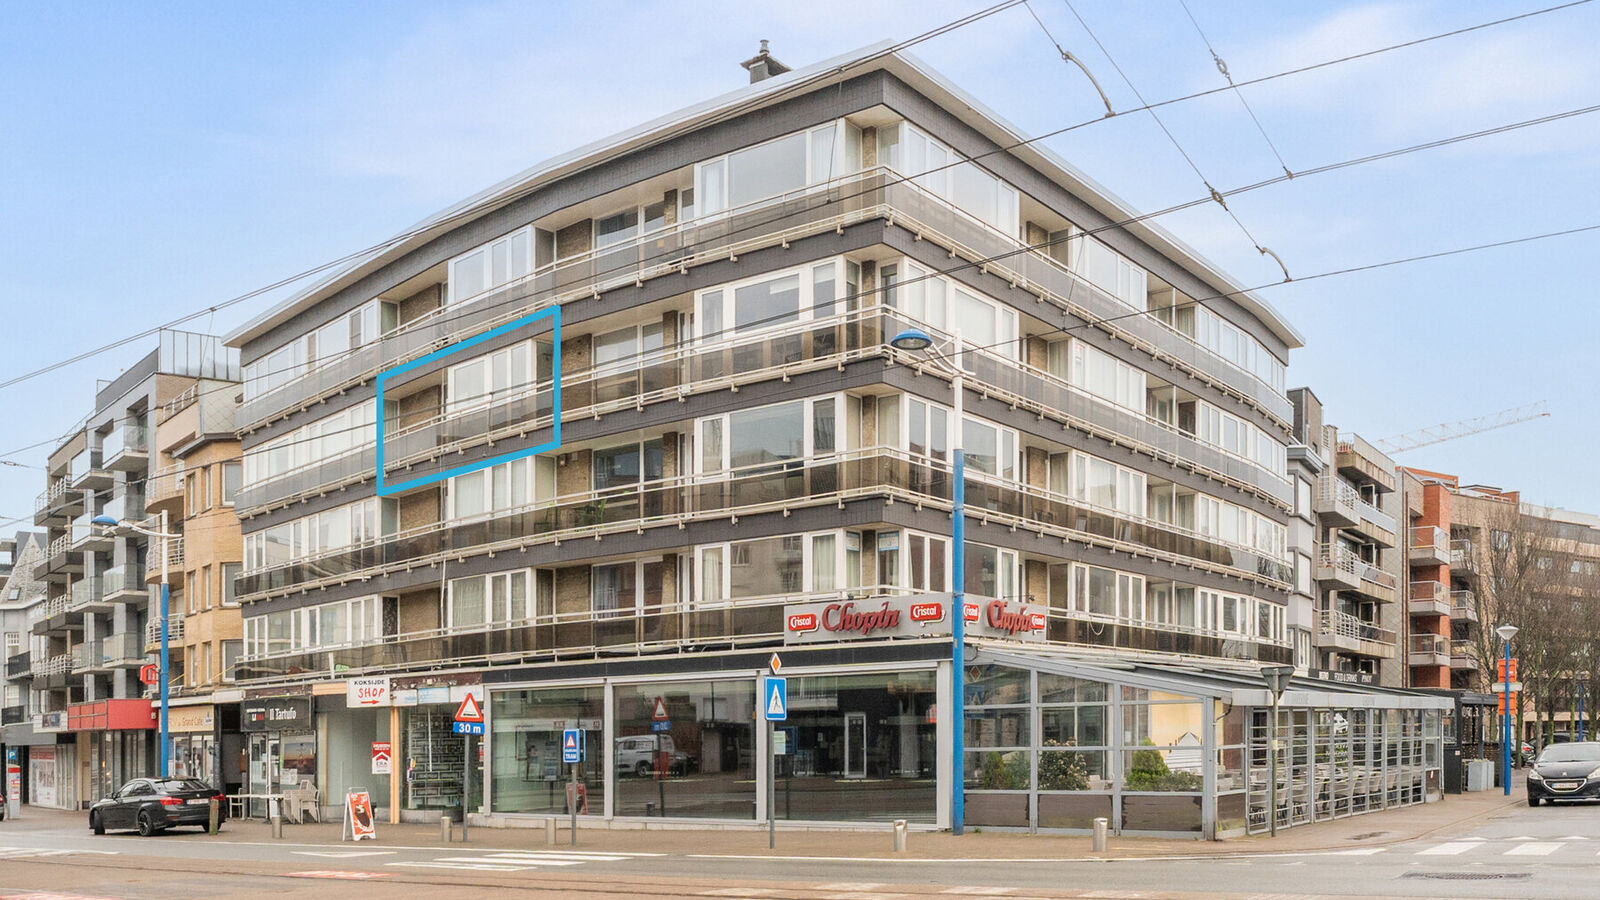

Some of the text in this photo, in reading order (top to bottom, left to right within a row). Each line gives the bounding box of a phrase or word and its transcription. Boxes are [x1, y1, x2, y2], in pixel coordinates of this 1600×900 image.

[822, 601, 900, 635] Chopin
[913, 604, 937, 619] Cristal
[987, 600, 1031, 635] Chopin
[790, 615, 812, 628] Cristal
[358, 688, 385, 698] SHOP
[276, 707, 296, 720] Tartufo
[458, 723, 470, 732] 30
